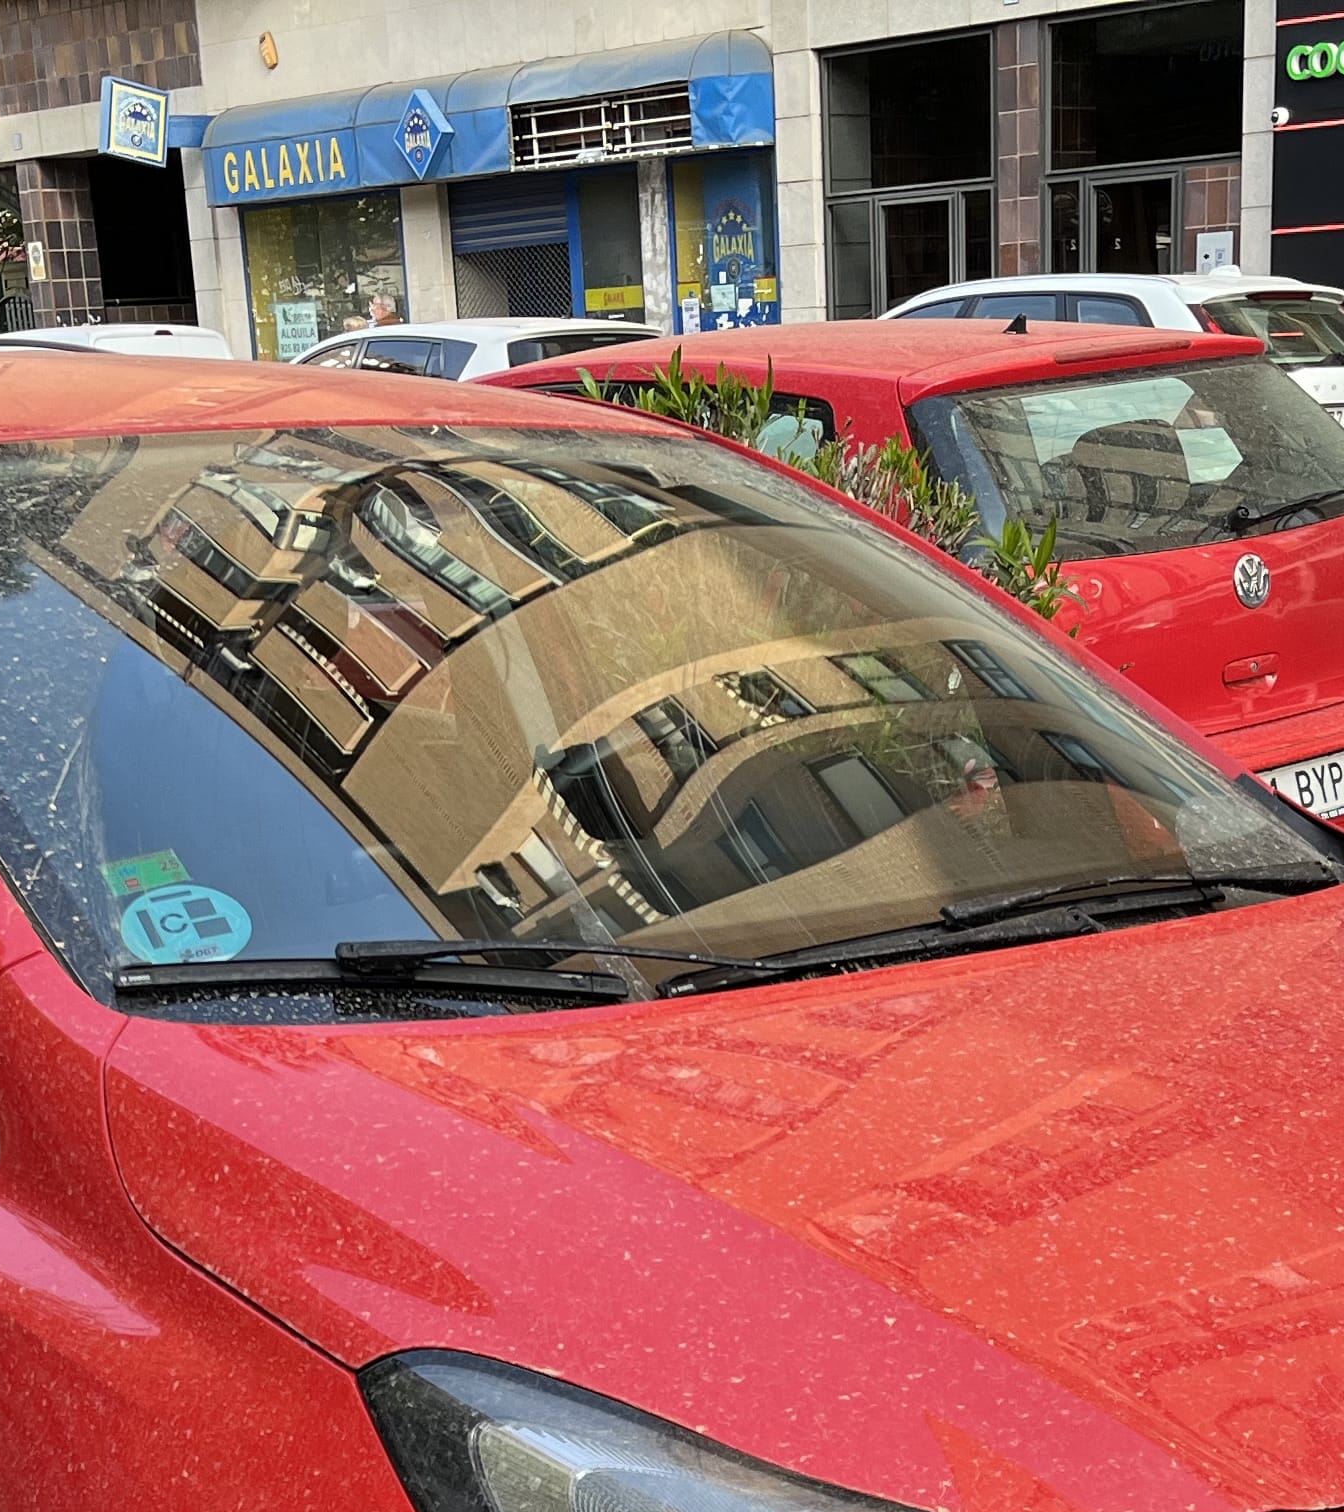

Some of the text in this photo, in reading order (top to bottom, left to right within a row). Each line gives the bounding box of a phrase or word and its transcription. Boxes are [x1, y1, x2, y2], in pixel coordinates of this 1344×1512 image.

[223, 136, 347, 195] GALAXIA
[712, 231, 755, 264] GALAXIA
[281, 327, 316, 339] ALQUILA
[1295, 761, 1344, 809] BYP
[159, 913, 189, 934] C
